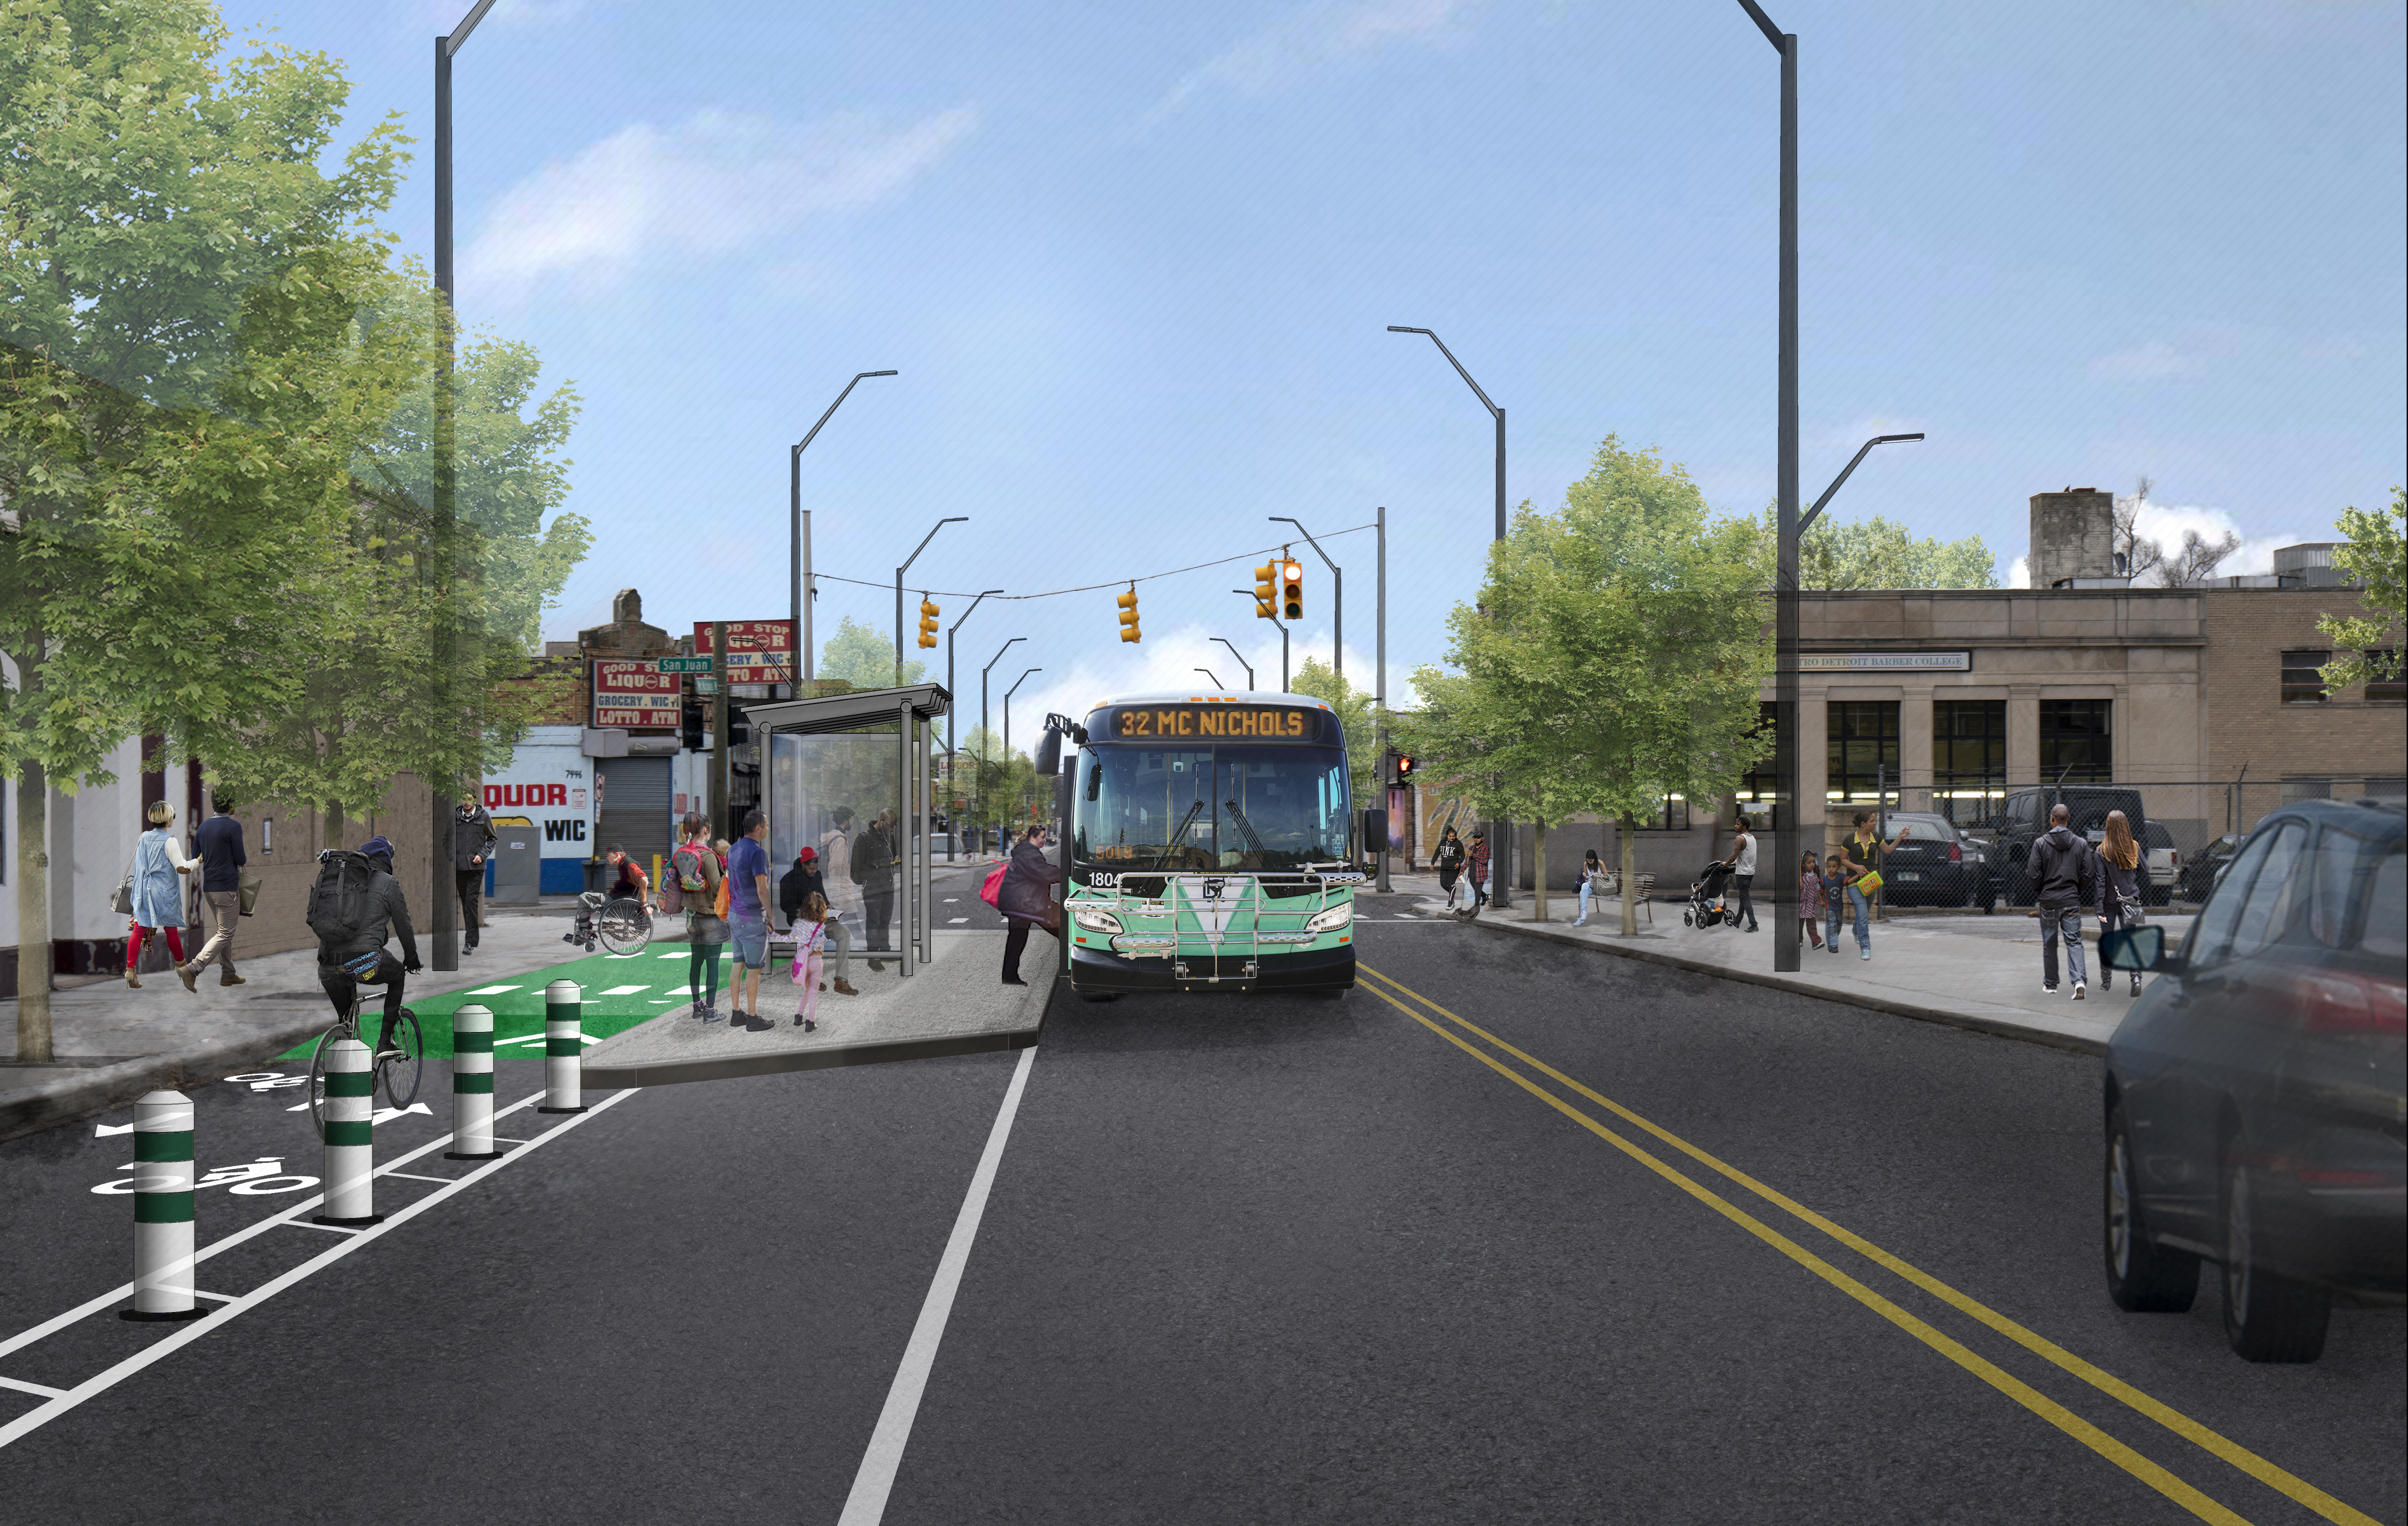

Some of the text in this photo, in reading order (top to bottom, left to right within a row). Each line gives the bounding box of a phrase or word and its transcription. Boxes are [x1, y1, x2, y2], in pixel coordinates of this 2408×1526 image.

[704, 624, 790, 636] GOD STOP
[663, 660, 708, 670] San Juan
[1822, 658, 1868, 666] DETROIT
[1871, 658, 1913, 666] BARBER
[1915, 657, 1962, 665] COLLEGE
[603, 663, 637, 674] GOOD
[599, 695, 669, 707] GROCERY WIC
[599, 710, 677, 724] LOTTO ATM
[1121, 711, 1302, 736] 32 MC NICHOLS
[565, 770, 582, 779] 7446
[544, 819, 586, 841] WIC
[1096, 845, 1132, 859] 5019
[1089, 872, 1123, 887] 1804
